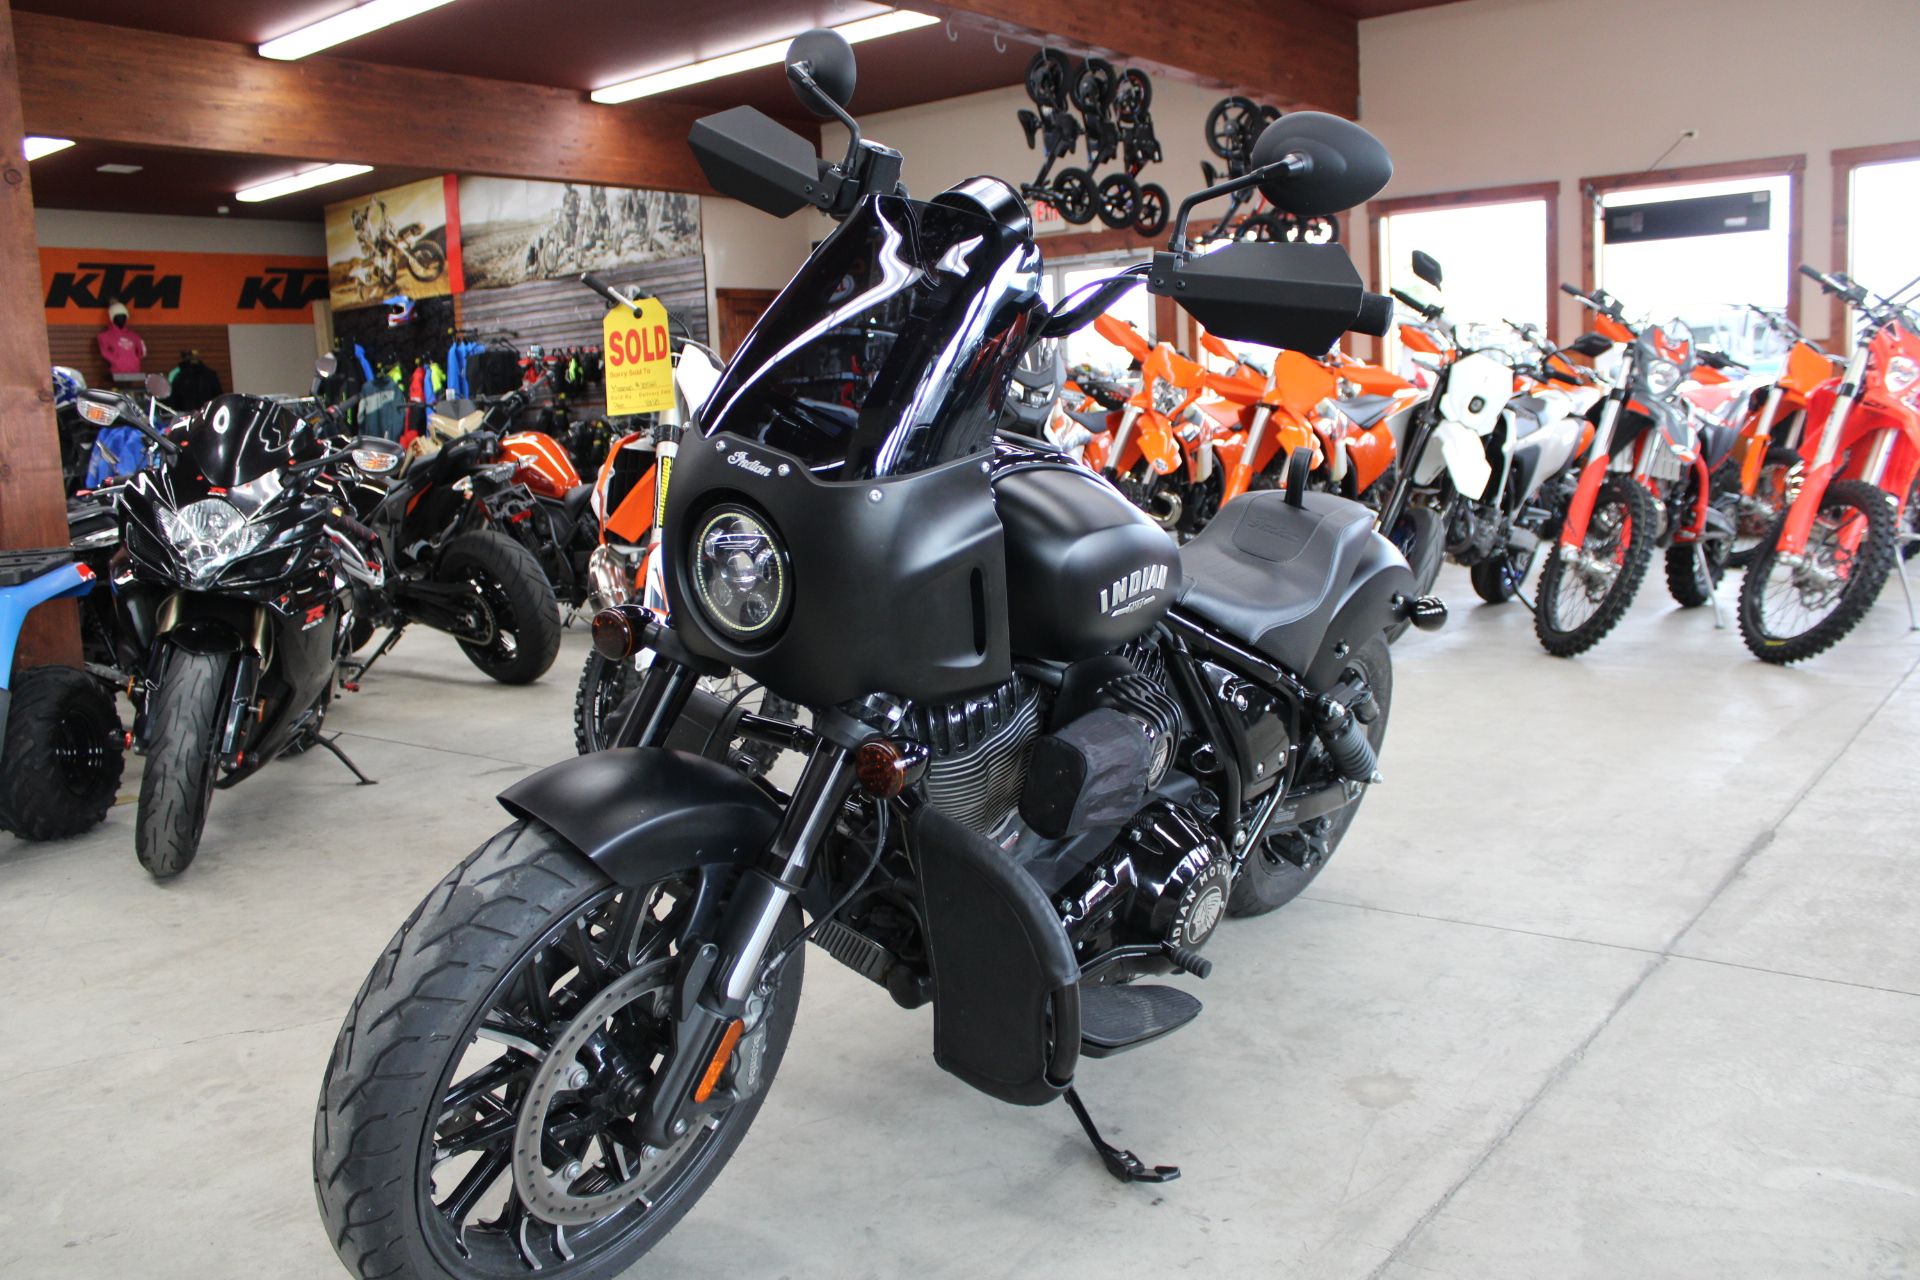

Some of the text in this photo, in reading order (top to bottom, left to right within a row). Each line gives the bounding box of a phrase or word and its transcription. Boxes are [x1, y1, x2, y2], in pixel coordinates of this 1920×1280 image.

[45, 262, 182, 309] KTM
[609, 325, 667, 366] SOLD
[727, 451, 772, 476] Indian
[1100, 564, 1168, 614] INDIAN
